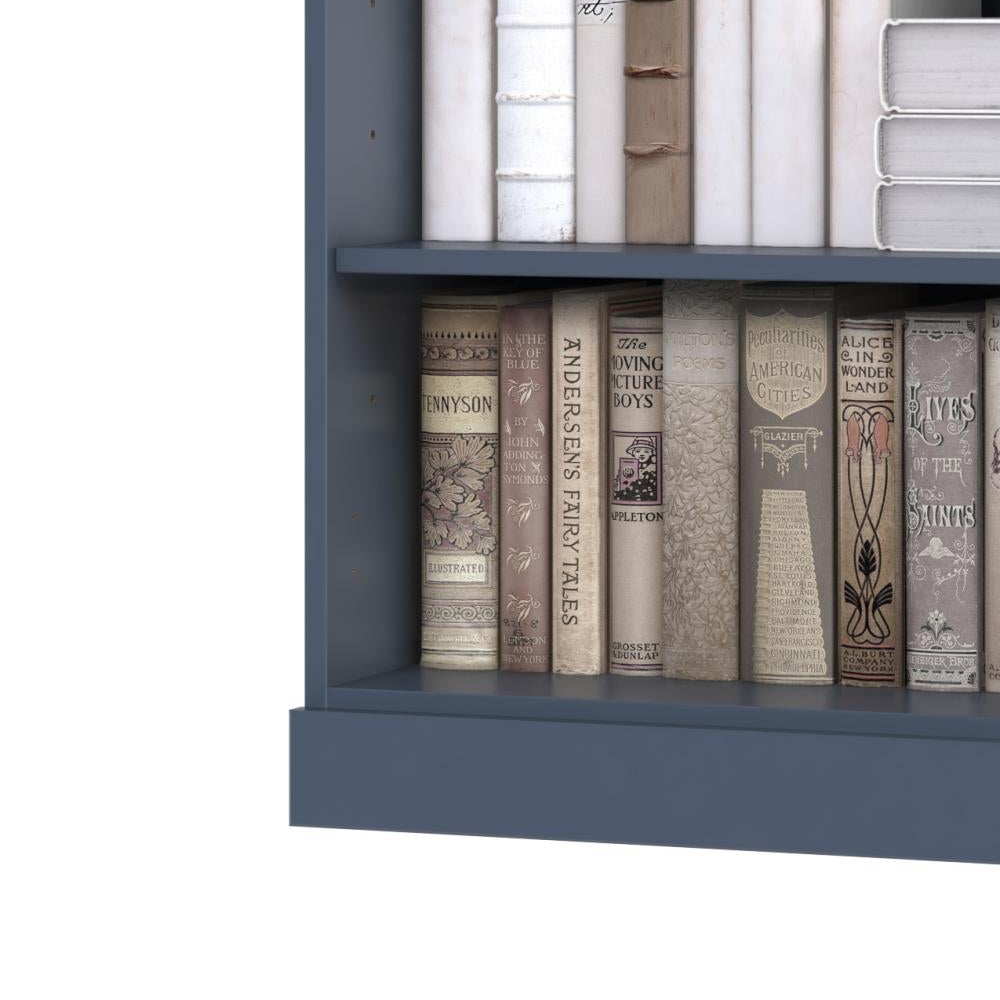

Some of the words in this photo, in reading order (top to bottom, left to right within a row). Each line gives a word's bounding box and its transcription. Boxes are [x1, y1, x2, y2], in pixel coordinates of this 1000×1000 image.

[519, 333, 546, 345] THE
[616, 337, 647, 350] The
[841, 335, 894, 349] ALICE
[526, 348, 544, 358] OF
[856, 352, 874, 363] IN
[506, 359, 540, 370] BLUE
[750, 360, 823, 383] AMERICAN
[841, 365, 894, 379] WONDER
[845, 381, 889, 394] LAND
[422, 394, 492, 415] TENNYSON
[613, 393, 654, 408] BOYS
[563, 338, 581, 480] ANDERSEN'S
[513, 416, 528, 427] BY
[763, 431, 805, 441] GLAZIER
[508, 437, 539, 448] JOHN
[913, 458, 928, 476] OF
[931, 457, 964, 480] THE
[562, 490, 581, 554] FAIRY
[611, 511, 665, 522] APPLETON
[428, 563, 486, 575] ILLUSTRATED
[561, 558, 580, 626] TALES
[612, 642, 661, 652] GROSSET
[843, 656, 894, 665] COMPANY
[863, 665, 894, 673] YORK
